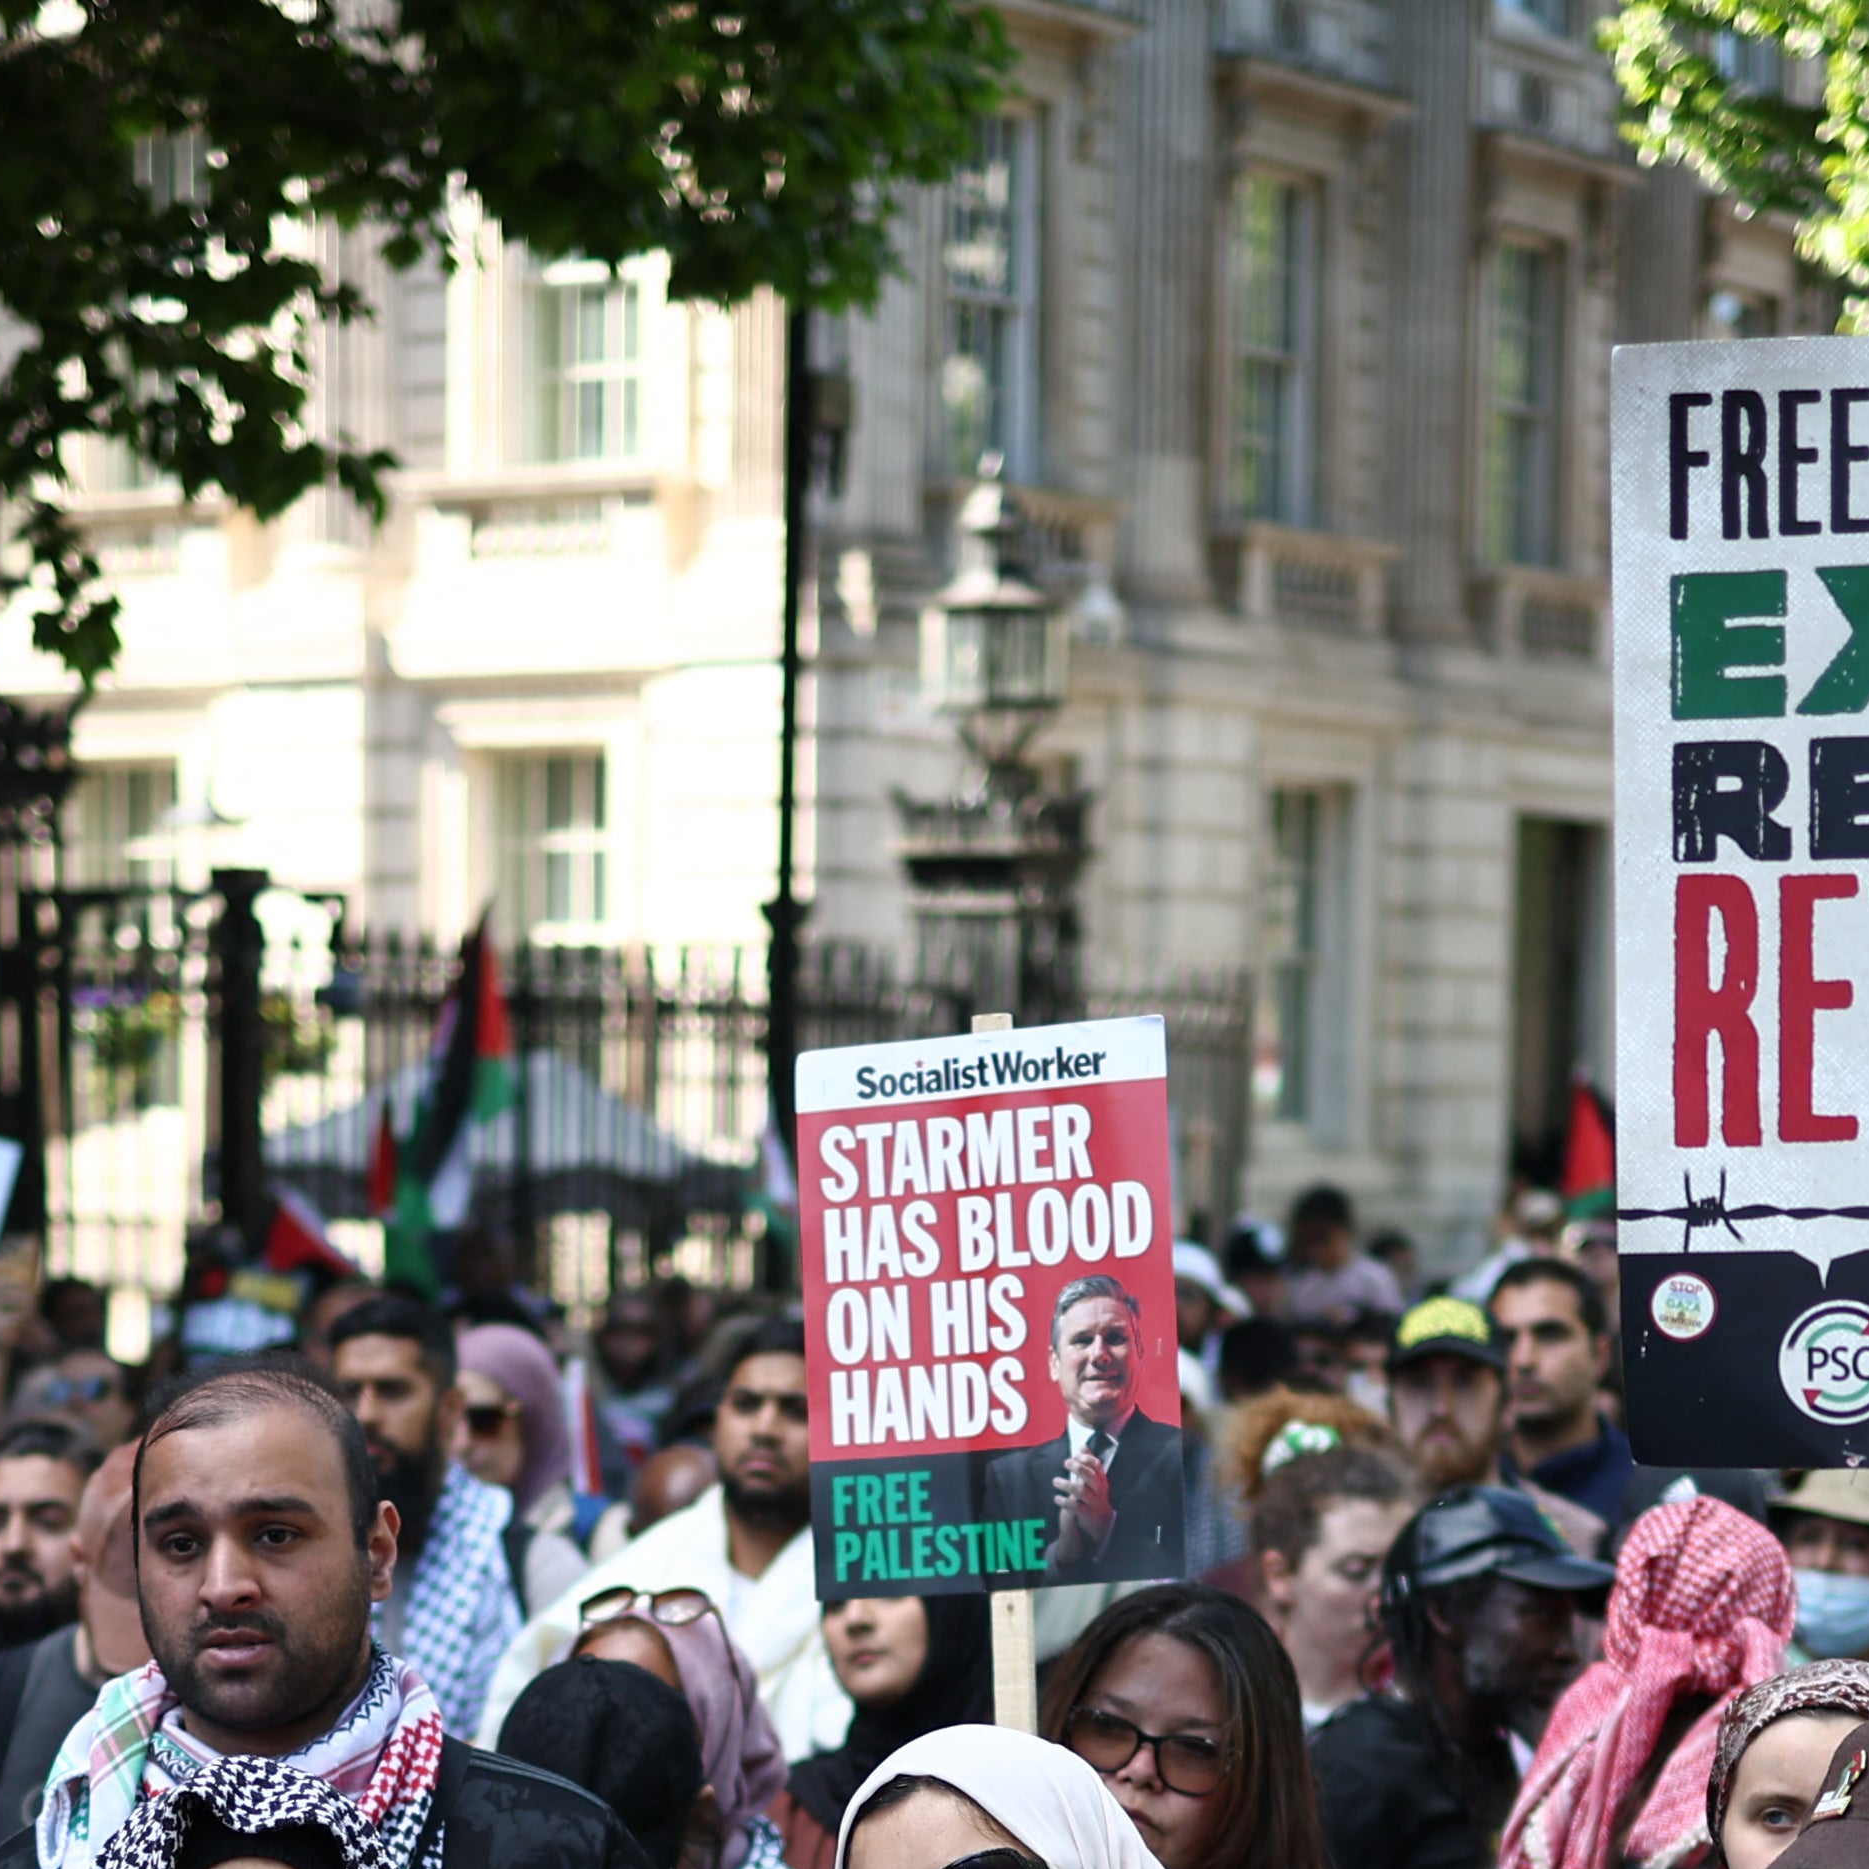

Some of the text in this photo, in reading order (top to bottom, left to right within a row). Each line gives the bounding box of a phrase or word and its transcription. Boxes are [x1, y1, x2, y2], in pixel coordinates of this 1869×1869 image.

[856, 1046, 1107, 1100] Socialist Worker
[818, 1104, 1093, 1204] STARMER
[823, 1180, 1154, 1284] HAS BLOOD
[825, 1274, 1028, 1365] ON HIS
[1666, 1298, 1701, 1312] GAZA
[1669, 1280, 1704, 1294] STOP
[829, 1355, 1029, 1447] HANDS
[832, 1470, 932, 1527] FREE
[833, 1518, 1048, 1583] PALESTINE
